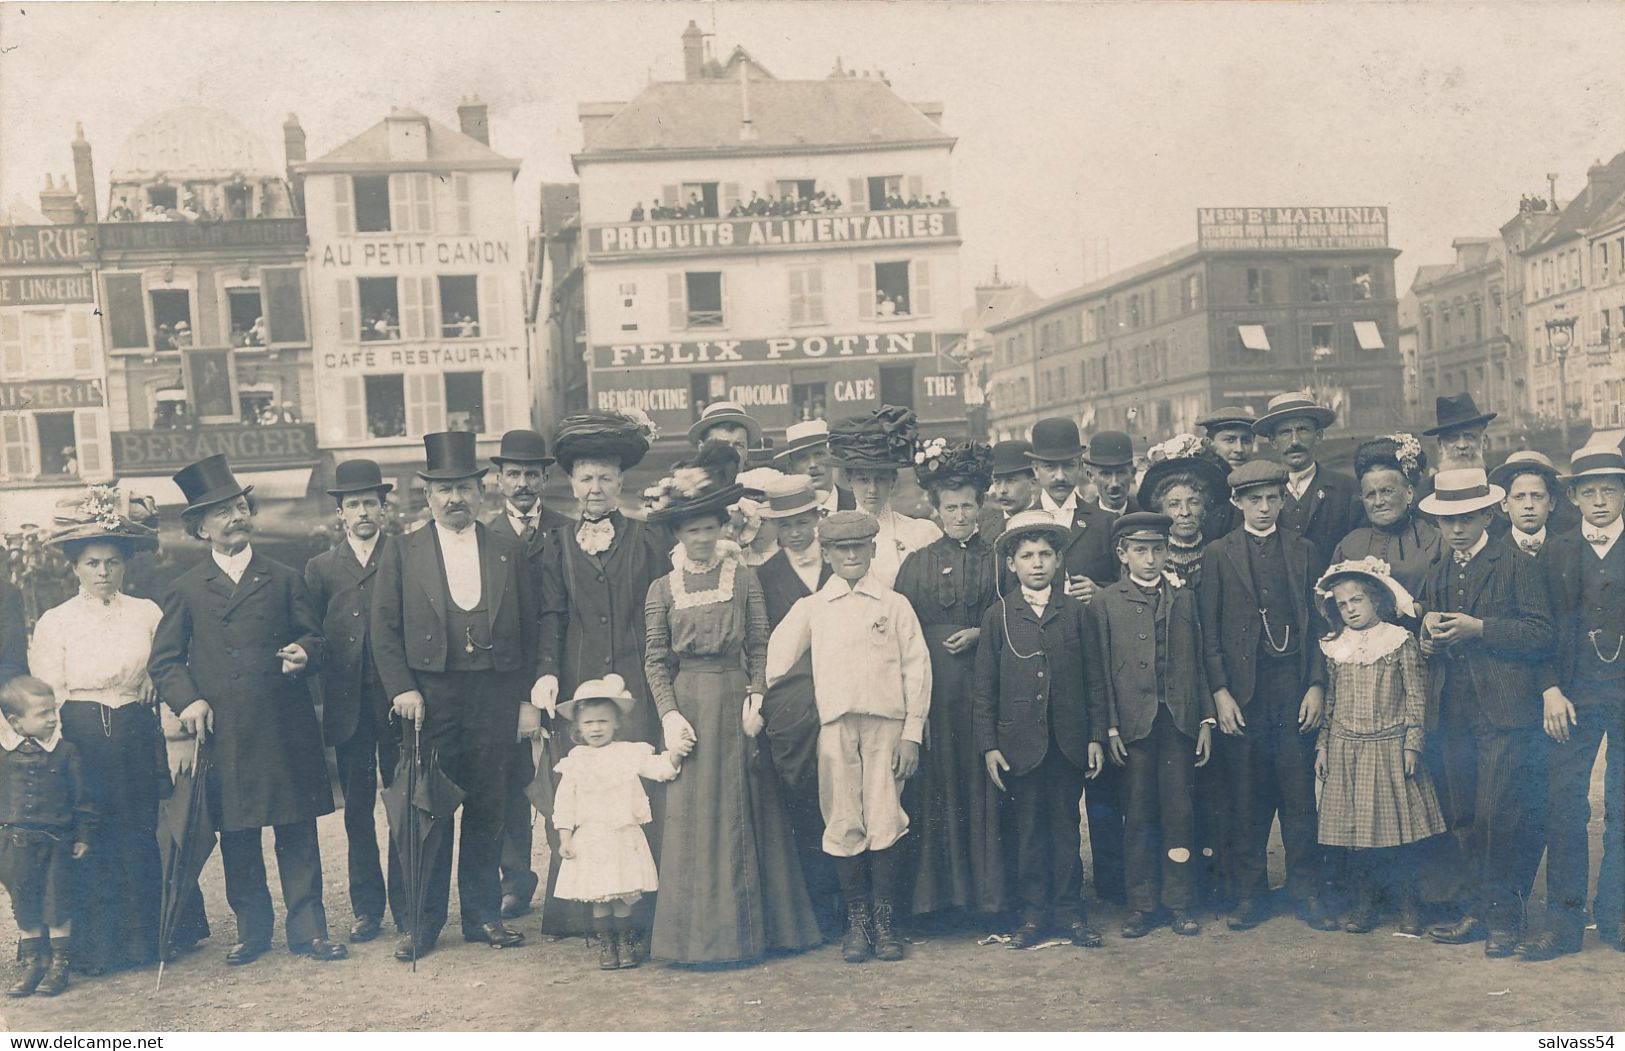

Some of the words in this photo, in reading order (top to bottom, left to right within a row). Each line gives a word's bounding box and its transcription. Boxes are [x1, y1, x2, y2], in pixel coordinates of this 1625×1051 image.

[1276, 207, 1386, 224] MARMINIA
[8, 238, 36, 260] DE
[38, 228, 91, 259] RUE
[601, 223, 735, 250] PRODUITS
[748, 213, 945, 246] ALIMENTAIRES
[322, 244, 352, 268] AU
[364, 241, 427, 267] PETIT
[437, 240, 510, 264] CANON
[20, 277, 92, 300] LINGERIE
[391, 346, 519, 366] RESTAURANT
[611, 341, 743, 366] FELIX
[766, 333, 916, 359] POTIN
[728, 383, 790, 406] CHOCOLAT
[119, 428, 312, 465] BERANGER
